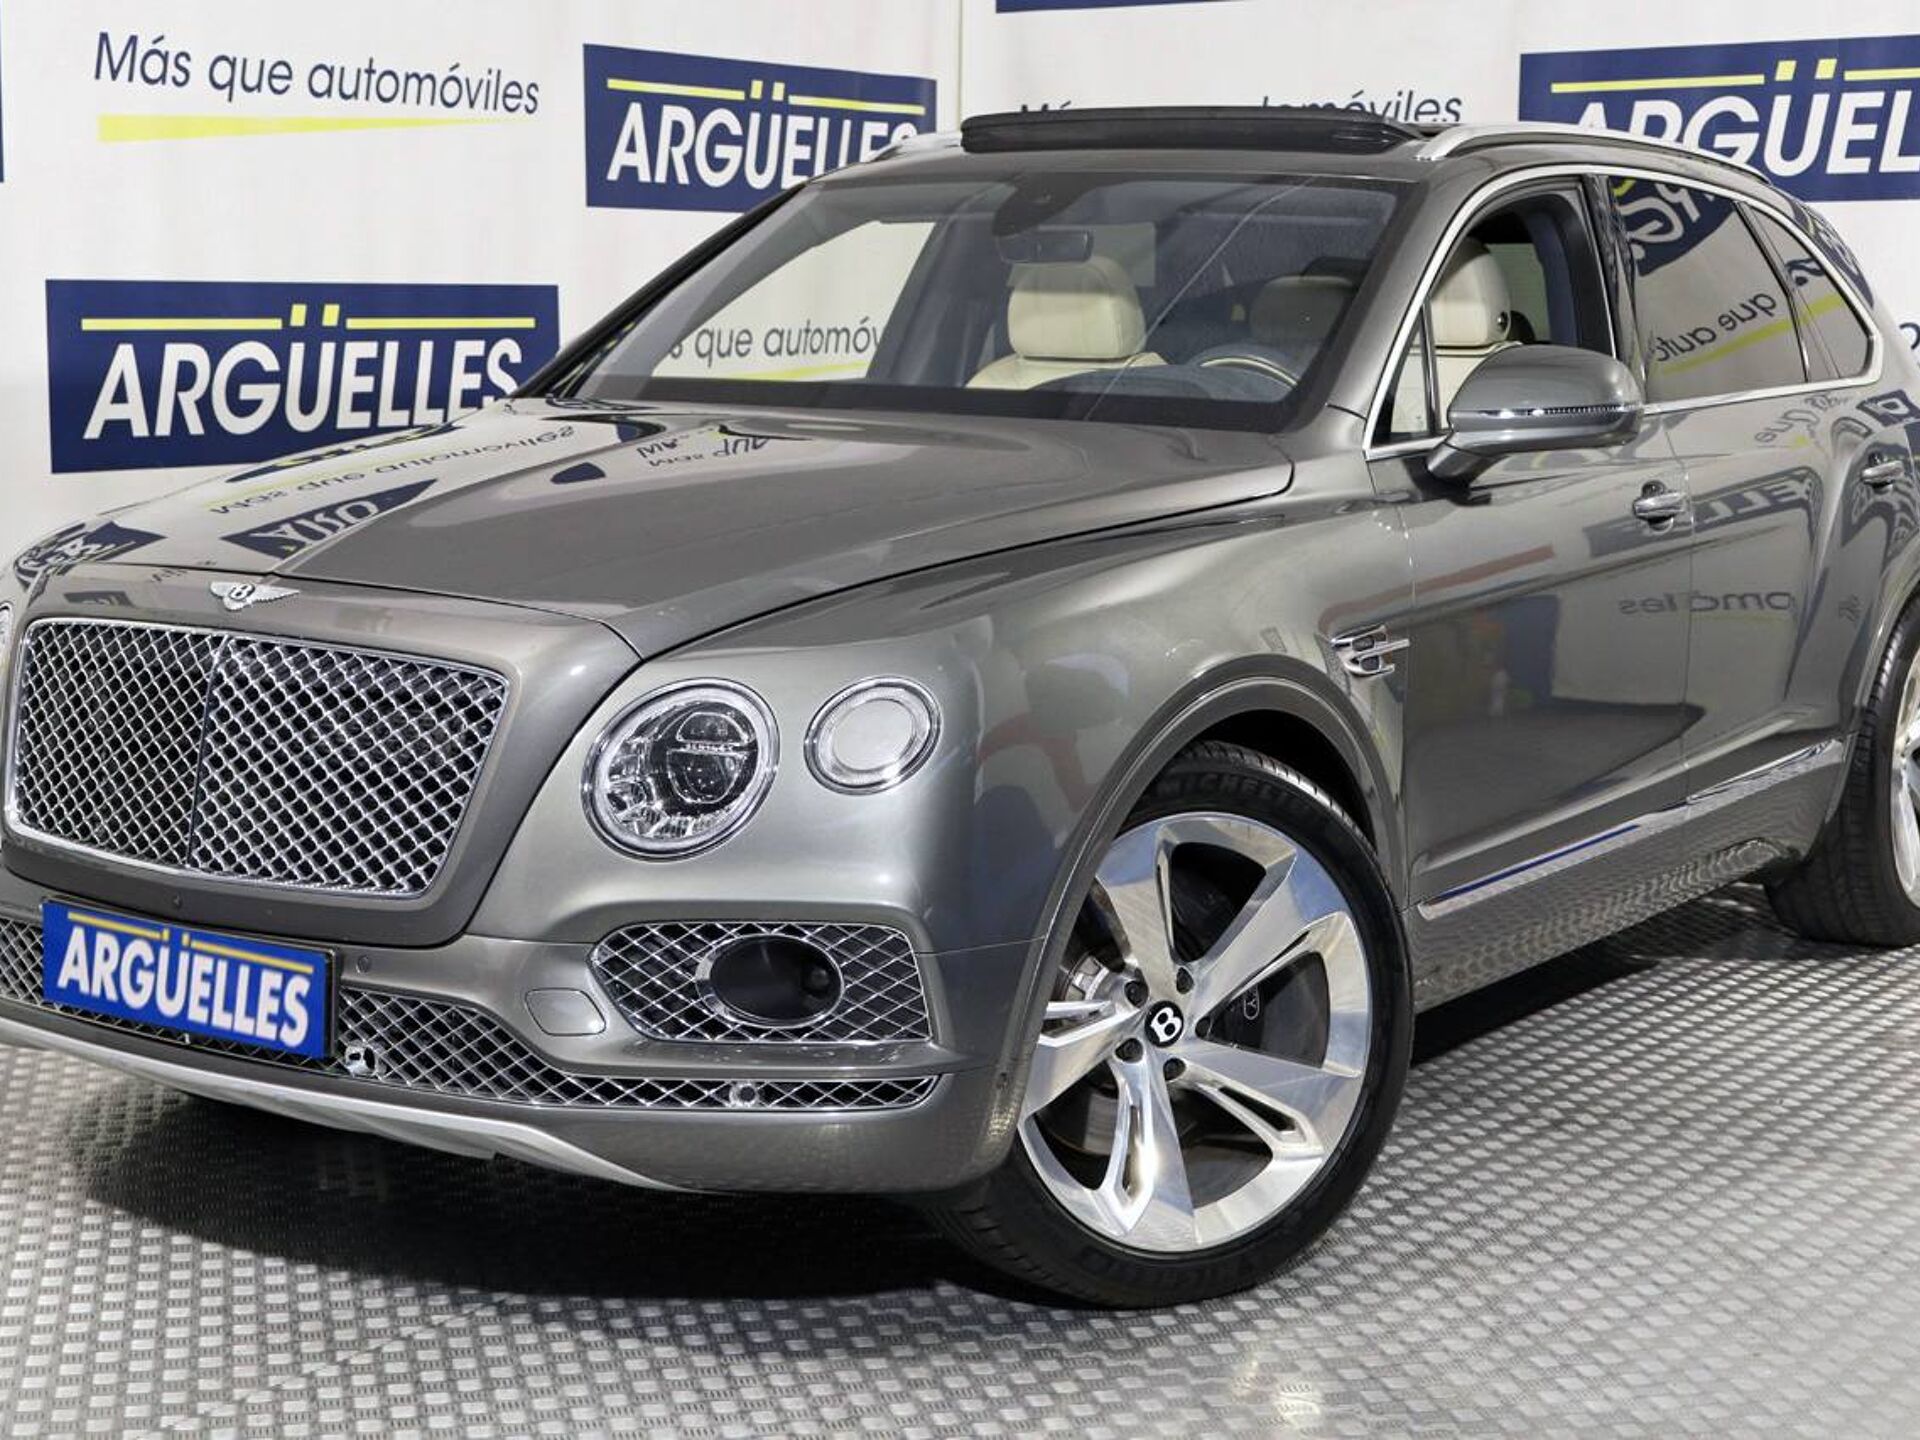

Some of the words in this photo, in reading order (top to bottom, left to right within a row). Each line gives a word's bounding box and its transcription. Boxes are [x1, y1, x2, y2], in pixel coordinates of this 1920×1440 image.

[94, 31, 192, 88] Más
[207, 53, 293, 104] que
[307, 57, 540, 115] automóviles
[606, 79, 918, 189] ARGÜELLE
[83, 303, 523, 440] ARGÜELLES
[694, 326, 753, 368] que
[57, 926, 312, 1048] ARGÜELLES
[1150, 1006, 1182, 1042] B
